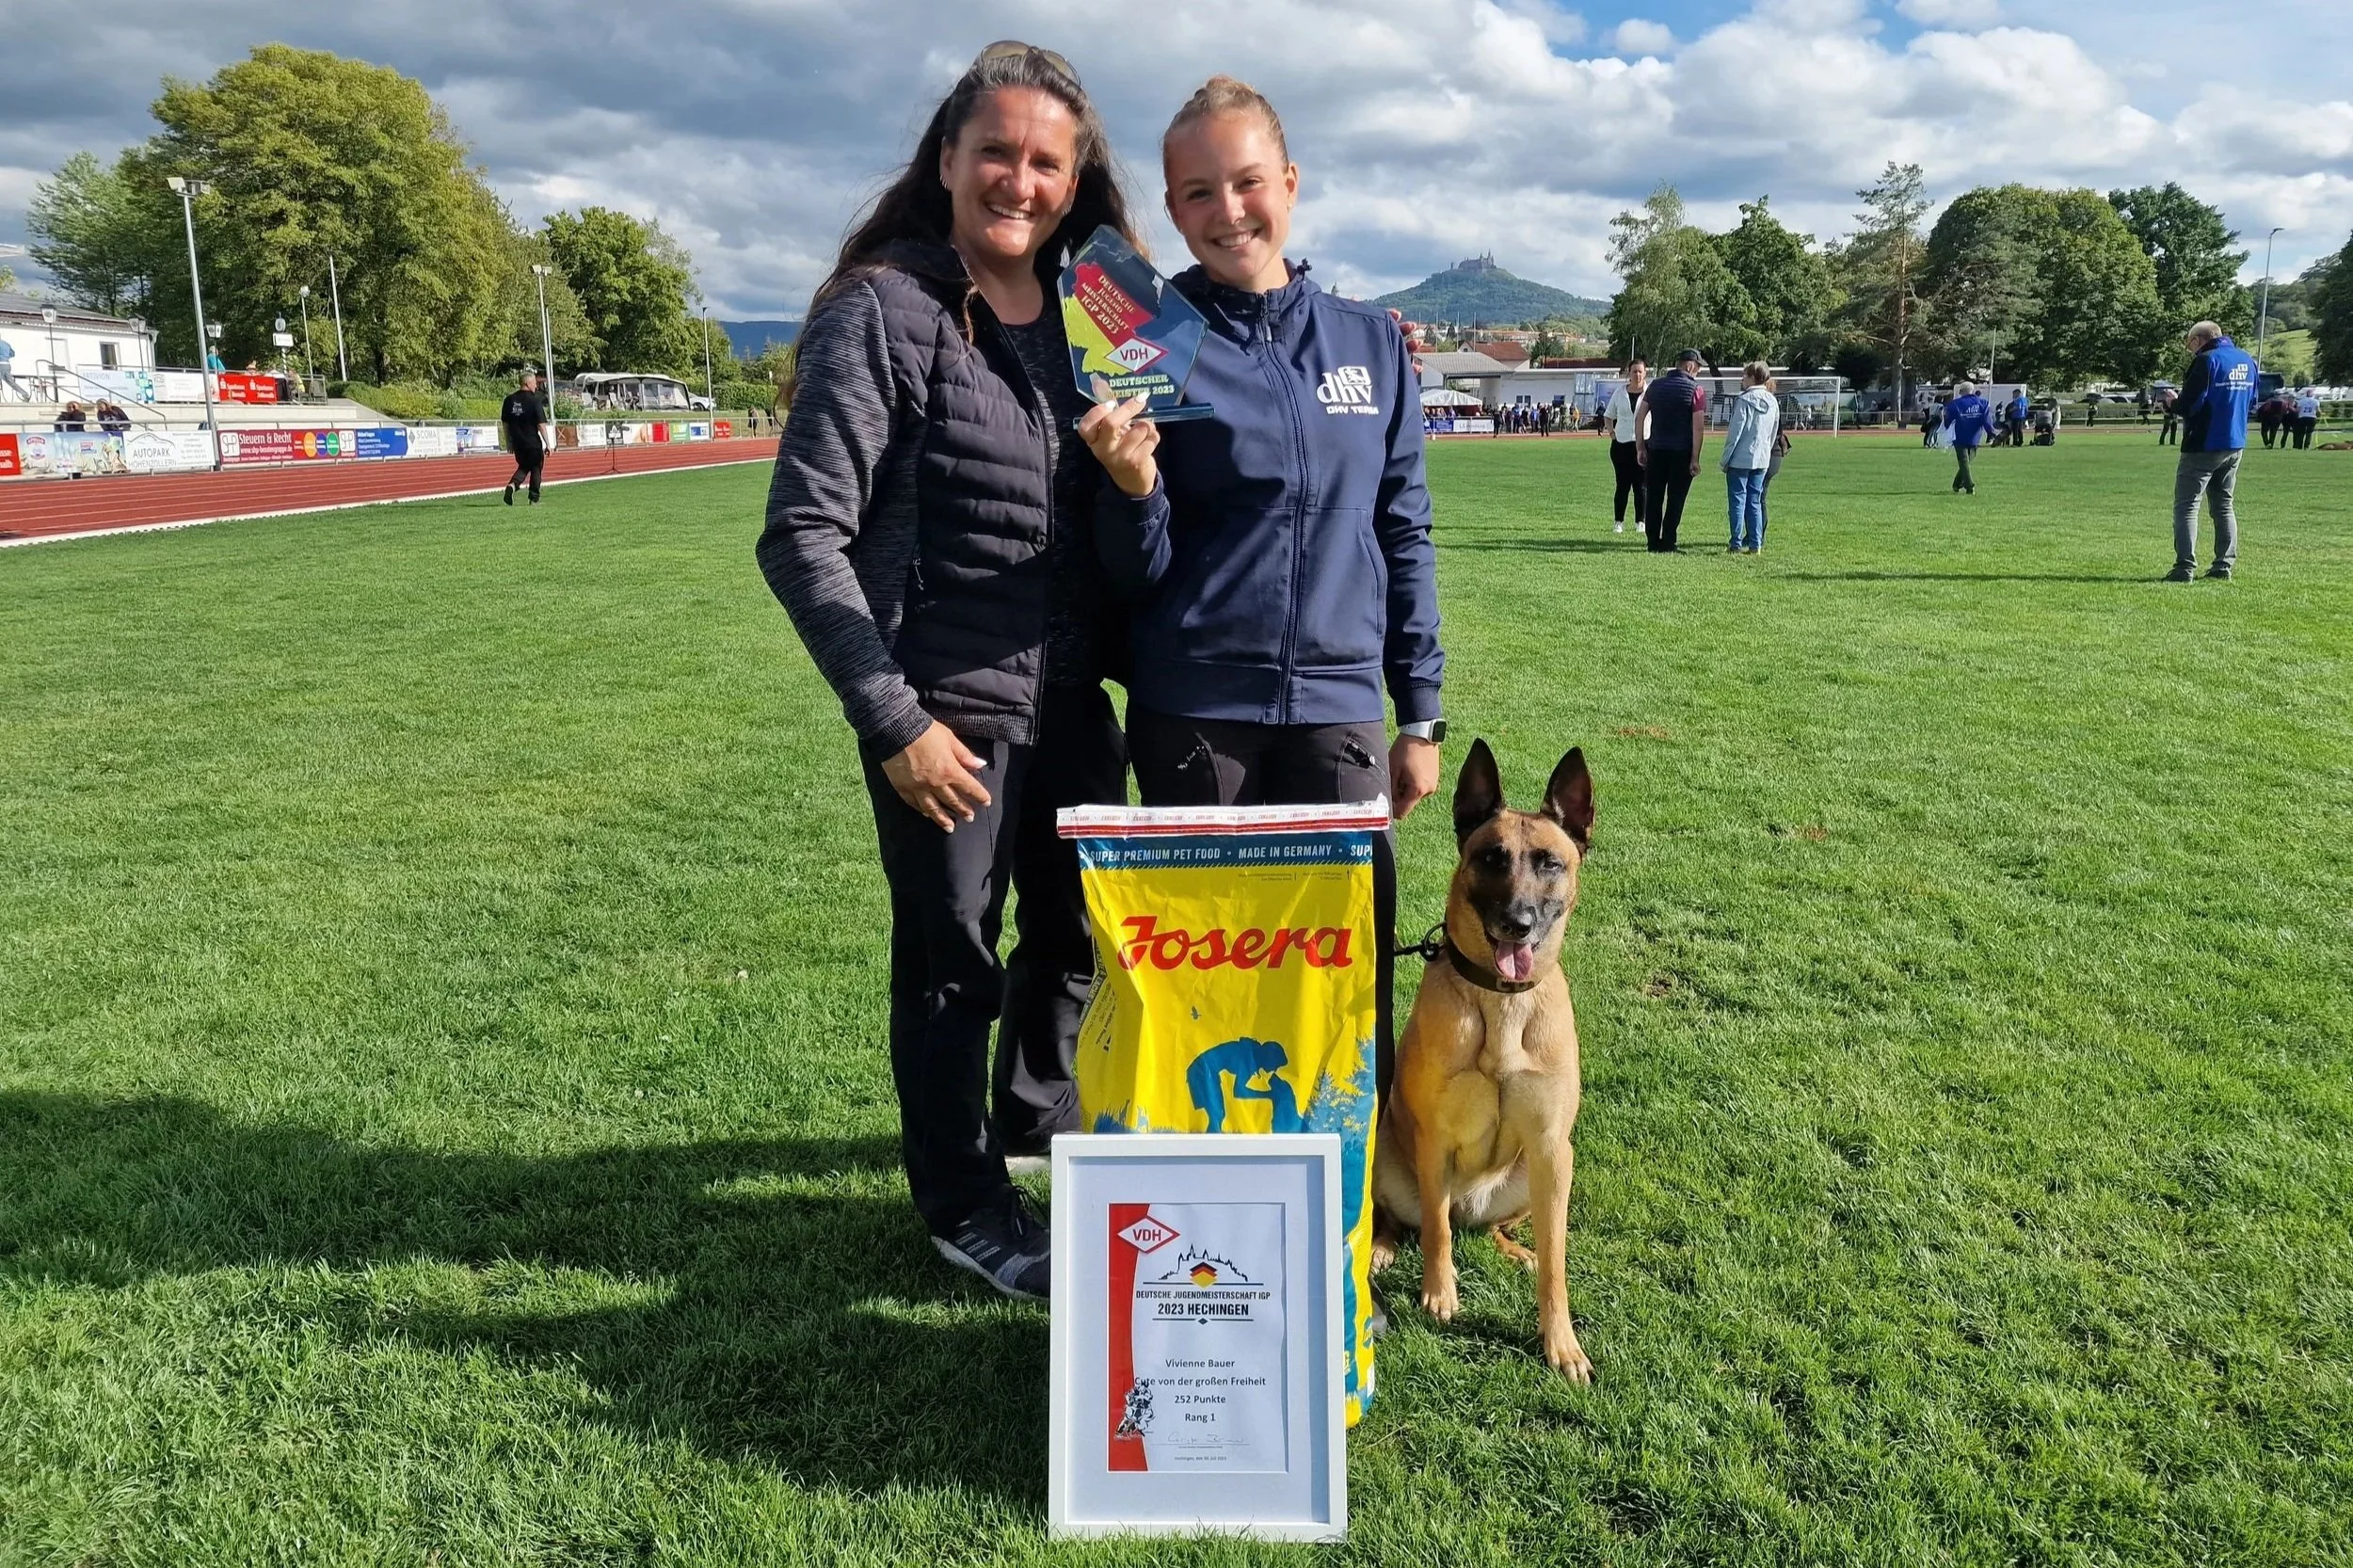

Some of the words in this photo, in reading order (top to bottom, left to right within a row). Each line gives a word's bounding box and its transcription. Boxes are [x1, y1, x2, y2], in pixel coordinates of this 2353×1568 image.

[1097, 288, 1123, 313] JUGEND
[1098, 275, 1134, 314] DEUTSCHE
[1081, 282, 1129, 330] MEISTERSCHAFT
[1081, 296, 1099, 312] IGP
[1096, 311, 1119, 334] 2023
[1120, 347, 1148, 361] VDH
[1109, 374, 1169, 388] DEUTSCHER
[1152, 384, 1175, 395] 2023
[1317, 372, 1372, 405] dhv
[239, 433, 265, 445] Steuern
[266, 433, 272, 444] &
[274, 431, 292, 444] Recht
[133, 447, 170, 458] AUTOPARK
[129, 458, 177, 469] HOHENZOLLERN
[1090, 850, 1121, 862] SUPER
[1124, 849, 1170, 861] PREMIUM
[1174, 848, 1193, 860] PET
[1195, 848, 1221, 859] FOOD
[1239, 847, 1266, 859] MADE
[1271, 846, 1280, 857] IN
[1284, 845, 1332, 857] GERMANY
[1116, 915, 1353, 971] Josera
[1132, 1228, 1161, 1241] VDH
[1136, 1290, 1172, 1299] DEUTSCHE
[1173, 1290, 1257, 1300] JUGENDMEISTERSCHAFT
[1258, 1291, 1271, 1301] IGP
[1158, 1303, 1184, 1315] 2023
[1188, 1303, 1249, 1316] HECHINGEN
[1165, 1359, 1206, 1368] Vivienne
[1208, 1359, 1235, 1368] Bauer
[1178, 1377, 1193, 1385] der
[1195, 1377, 1228, 1387] großen
[1230, 1377, 1266, 1385] Freiheit
[1174, 1395, 1192, 1403] 252
[1193, 1395, 1226, 1403] Punkte
[1185, 1413, 1208, 1424] Rang
[1210, 1413, 1216, 1421] 1
